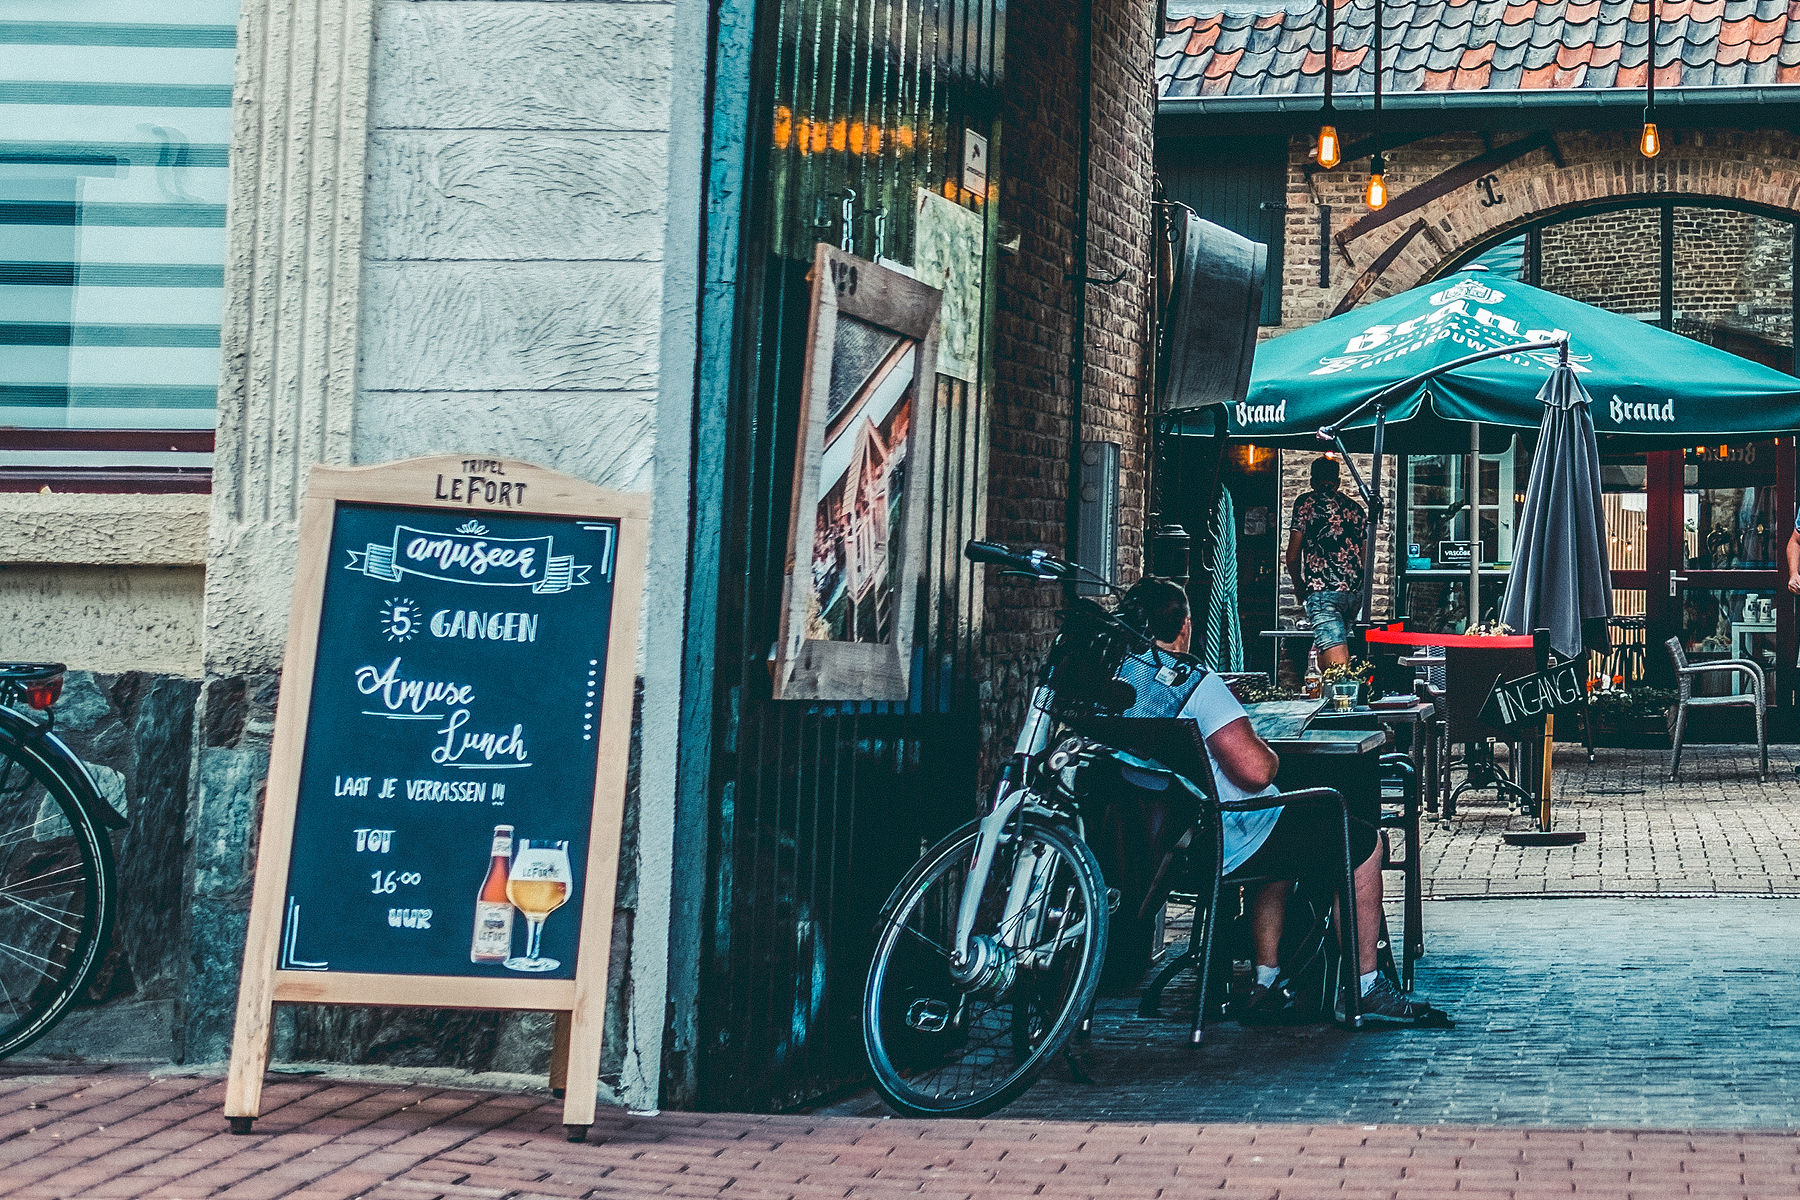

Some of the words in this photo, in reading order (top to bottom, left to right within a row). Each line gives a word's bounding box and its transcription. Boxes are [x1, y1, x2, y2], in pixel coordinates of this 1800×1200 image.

[1360, 328, 1531, 370] BIERBROUWRIJ
[1235, 399, 1287, 427] Brand
[1609, 394, 1676, 424] Brand
[461, 459, 506, 476] TRIPEL
[391, 606, 412, 636] 5
[429, 608, 539, 642] GANGEN
[354, 656, 476, 714] Amuse
[431, 708, 529, 764] Lunch
[334, 775, 371, 797] LAAT
[378, 777, 398, 799] JE
[405, 779, 487, 803] VERRASSEN
[353, 828, 397, 854] TOT
[388, 908, 433, 930] UUR
